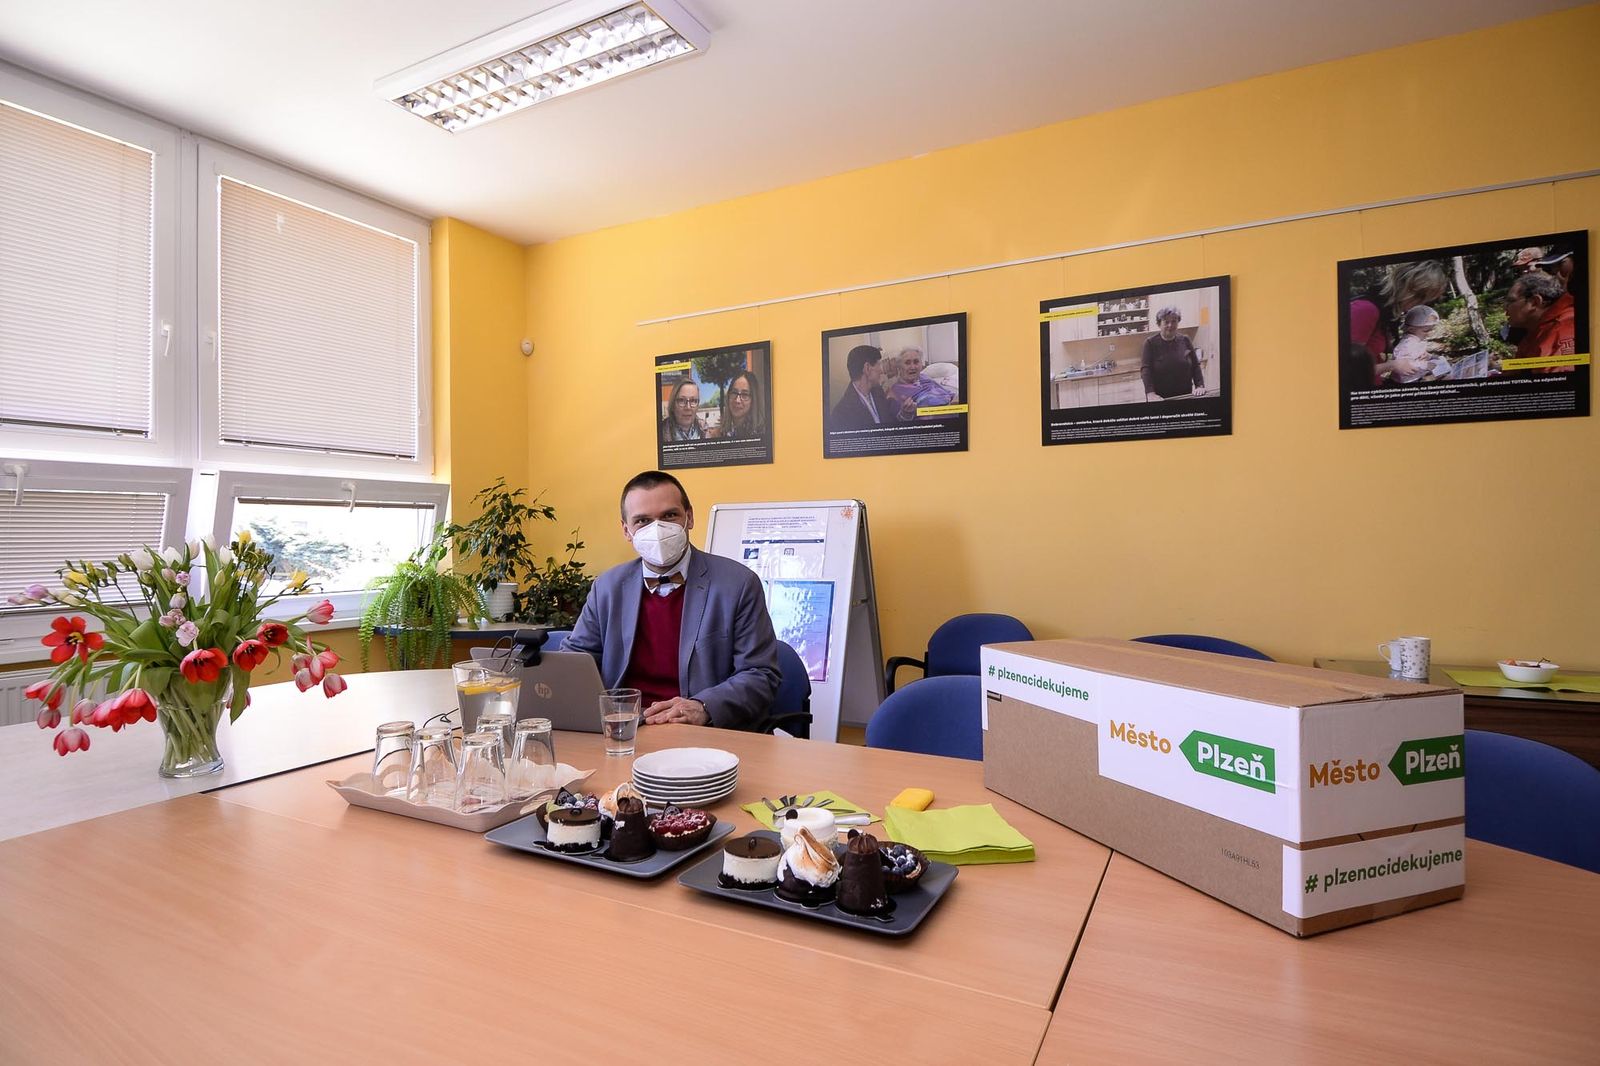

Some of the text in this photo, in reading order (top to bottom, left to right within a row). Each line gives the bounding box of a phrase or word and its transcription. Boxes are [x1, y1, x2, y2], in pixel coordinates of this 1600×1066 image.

[998, 666, 1089, 701] plzenacidekujeme
[1110, 719, 1266, 782] Město Plzeň
[1310, 744, 1460, 788] Město Plzeň
[1324, 849, 1463, 892] plzenacidekujeme
